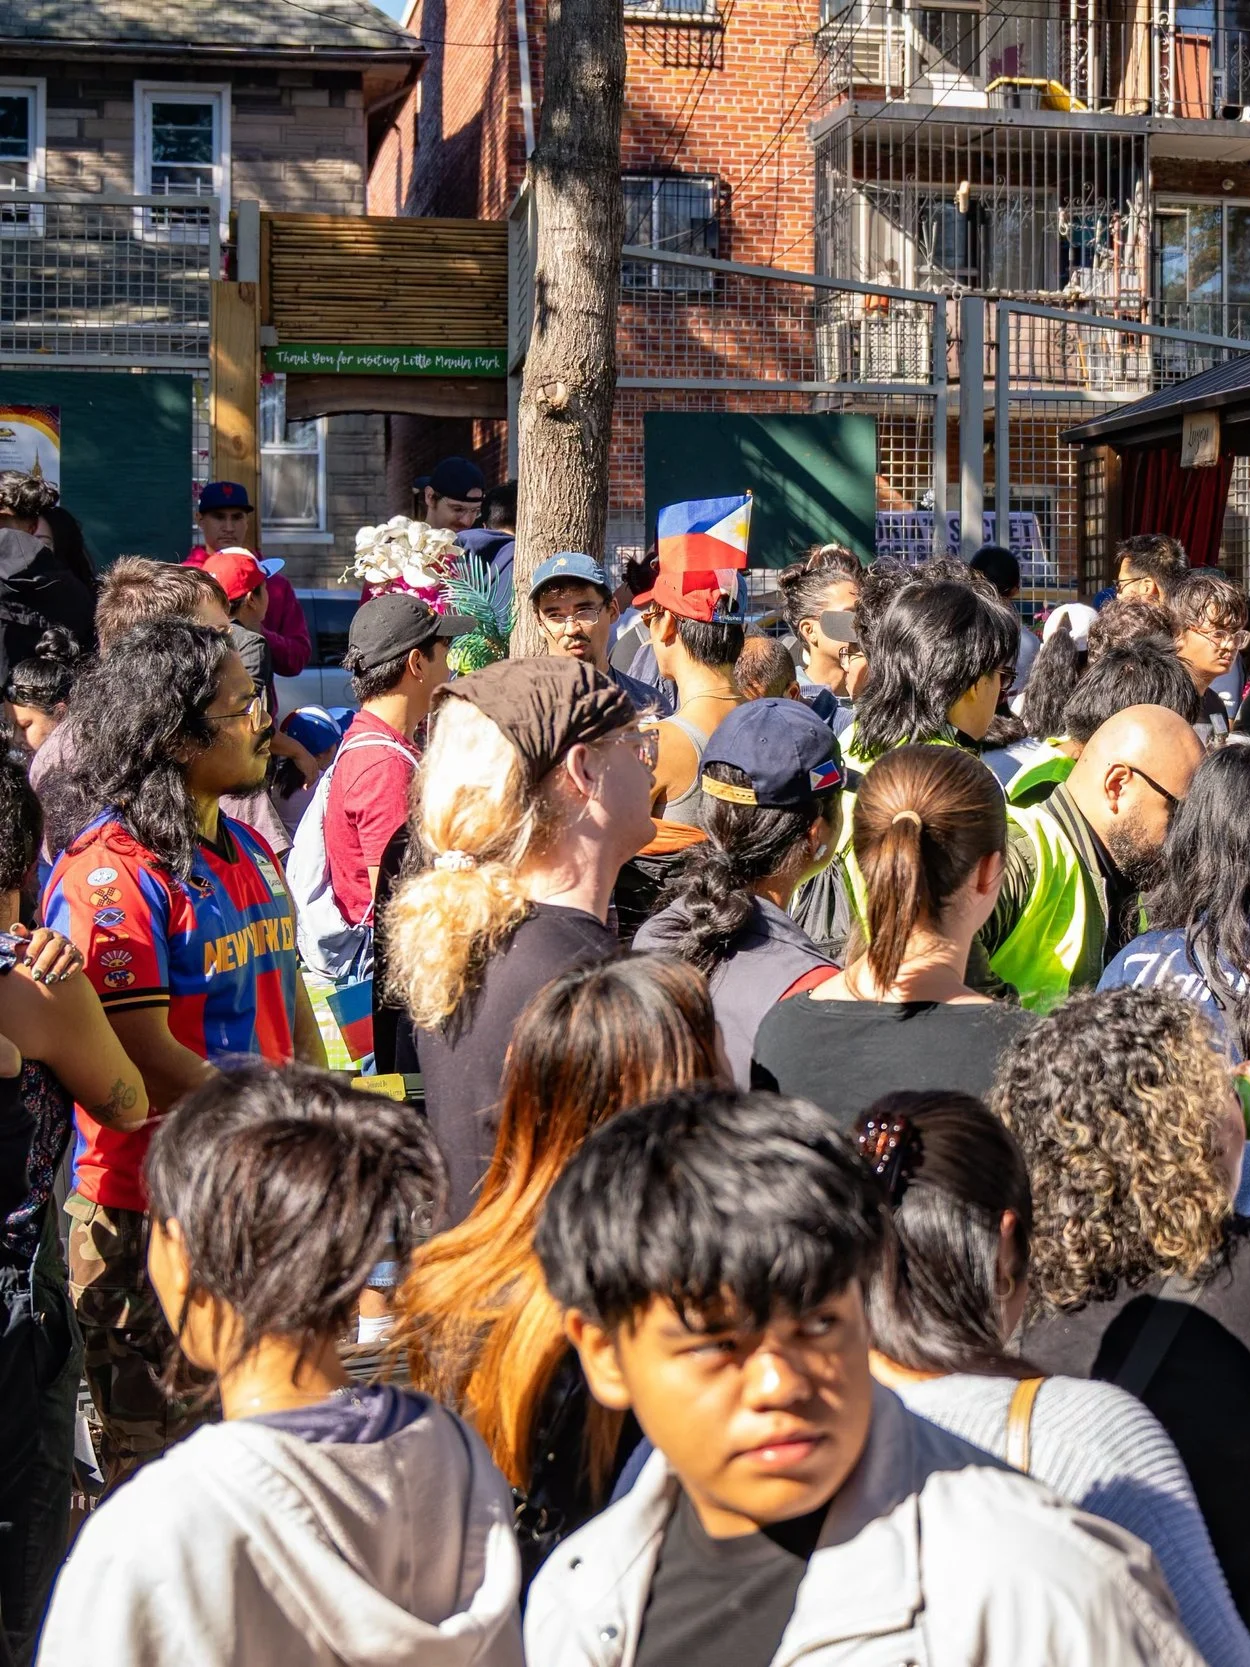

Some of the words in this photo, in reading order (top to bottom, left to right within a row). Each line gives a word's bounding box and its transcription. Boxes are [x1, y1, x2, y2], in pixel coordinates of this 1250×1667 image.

[276, 350, 310, 366] Thank
[312, 352, 334, 366] You
[335, 350, 354, 372] for
[357, 354, 400, 373] visiting
[403, 353, 432, 369] Little
[435, 355, 472, 370] Manila
[474, 355, 500, 370] Park
[949, 518, 1033, 543] SCET
[204, 927, 249, 975] NEW
